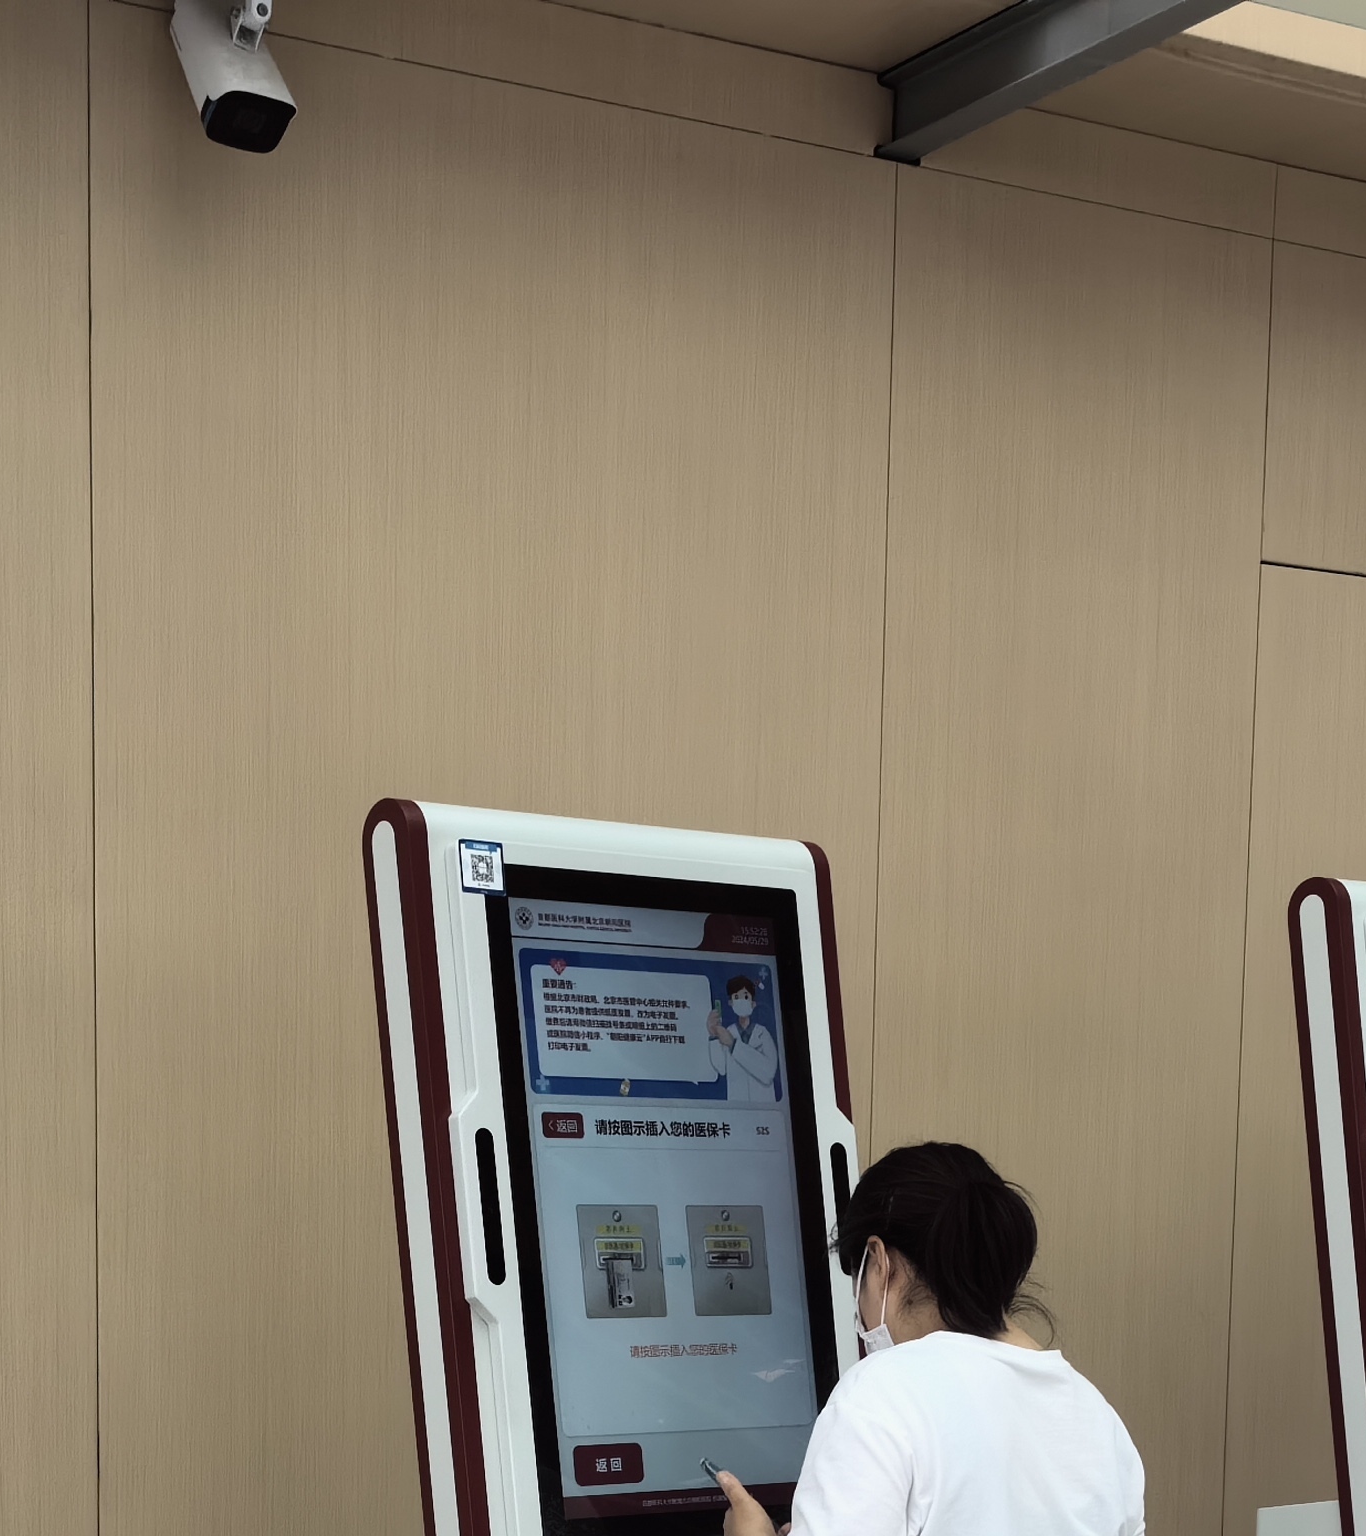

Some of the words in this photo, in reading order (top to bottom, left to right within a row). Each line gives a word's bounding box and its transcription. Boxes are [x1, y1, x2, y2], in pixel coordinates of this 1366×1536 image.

[595, 1119, 731, 1139] 请按图示插入您的医保卡
[595, 1457, 622, 1473] 返回
